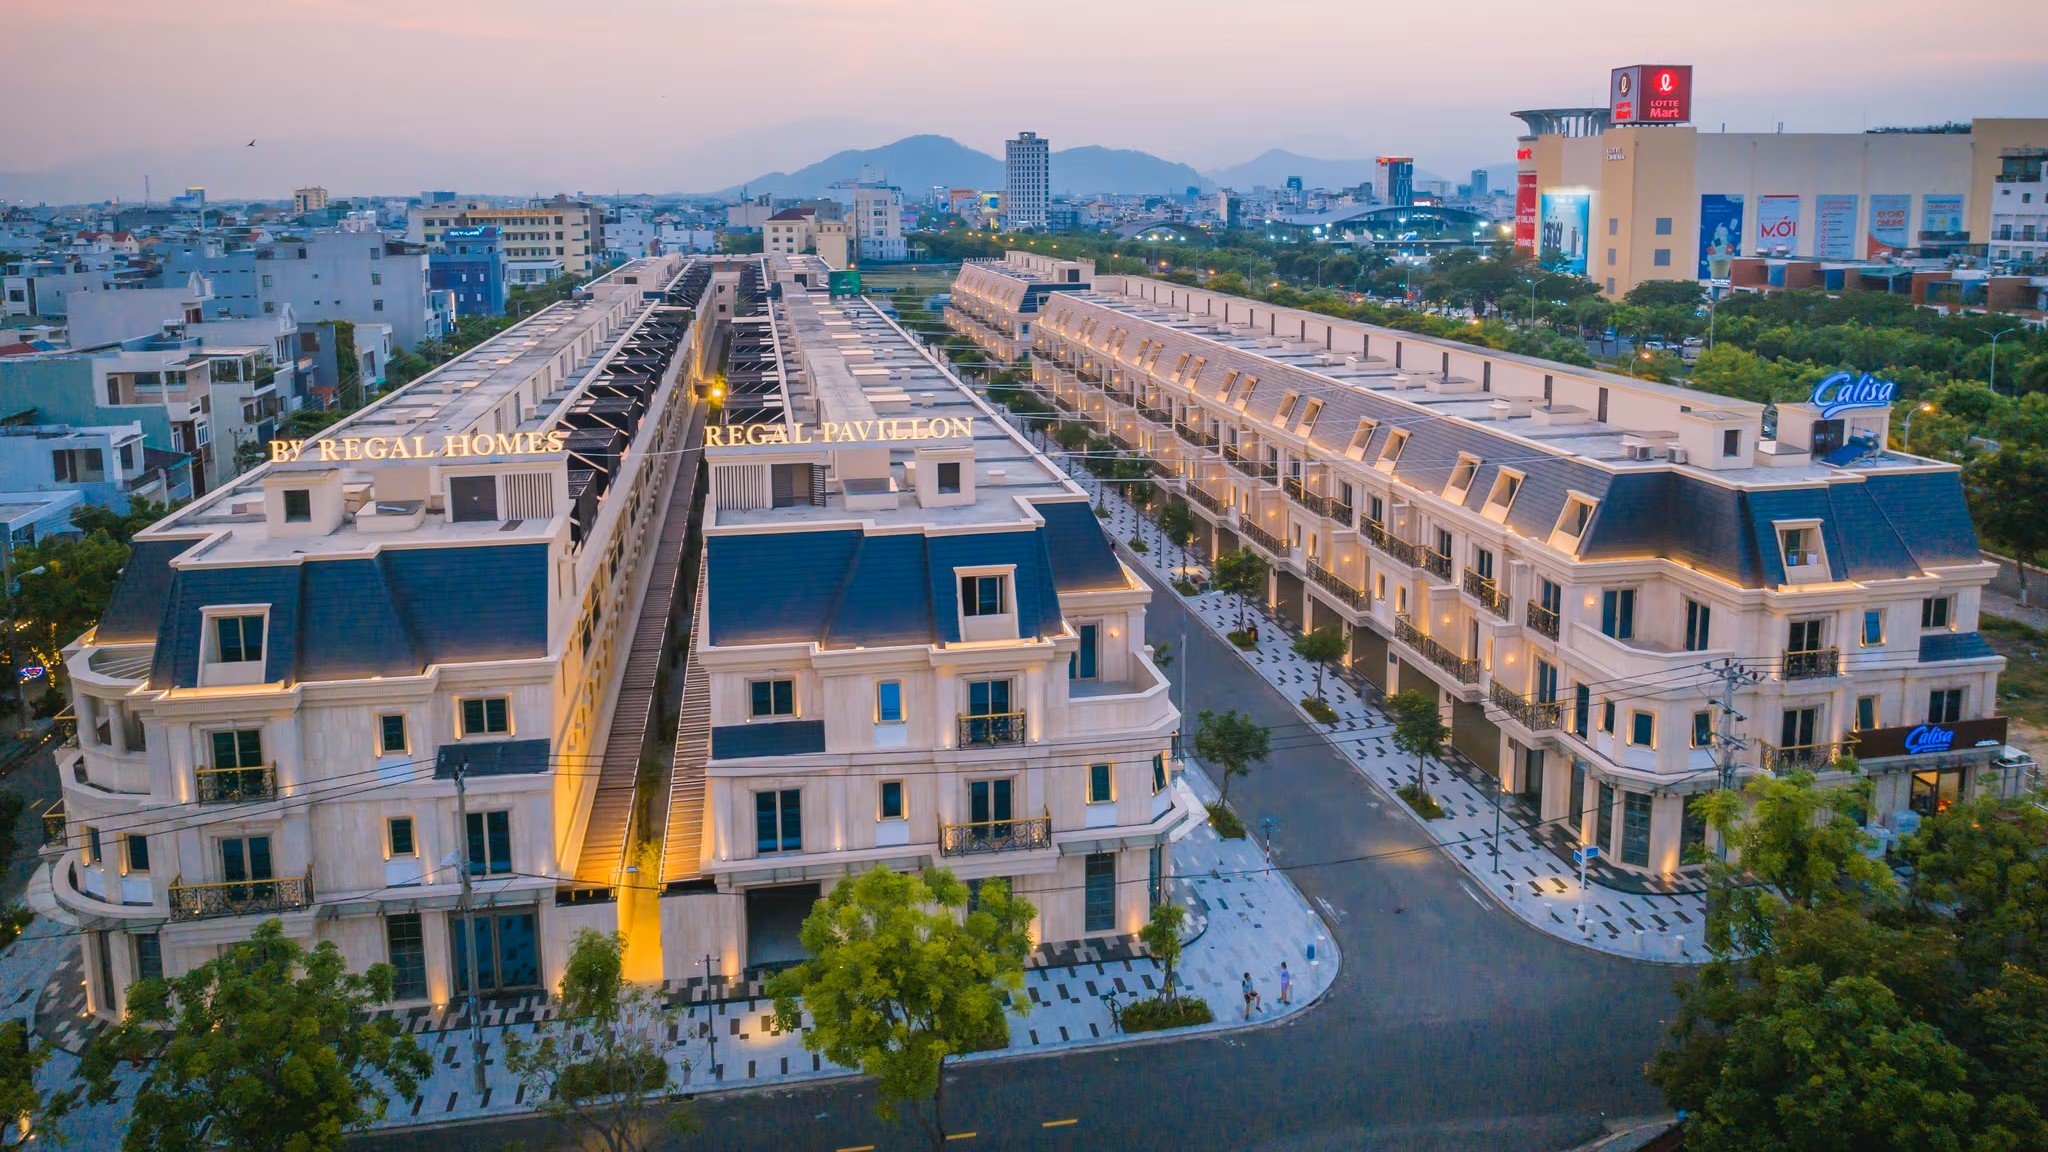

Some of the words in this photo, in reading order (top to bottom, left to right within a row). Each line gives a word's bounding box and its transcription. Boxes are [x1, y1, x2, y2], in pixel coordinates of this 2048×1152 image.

[1650, 108, 1679, 117] Mart
[1517, 148, 1532, 159] art
[1761, 215, 1796, 238] MỚI
[1814, 372, 1894, 411] Calisa
[704, 422, 812, 447] REGAL
[821, 416, 974, 443] PAVILLON
[317, 435, 434, 462] REGAL
[443, 430, 564, 457] HOMES
[1905, 725, 1954, 751] Calisa
